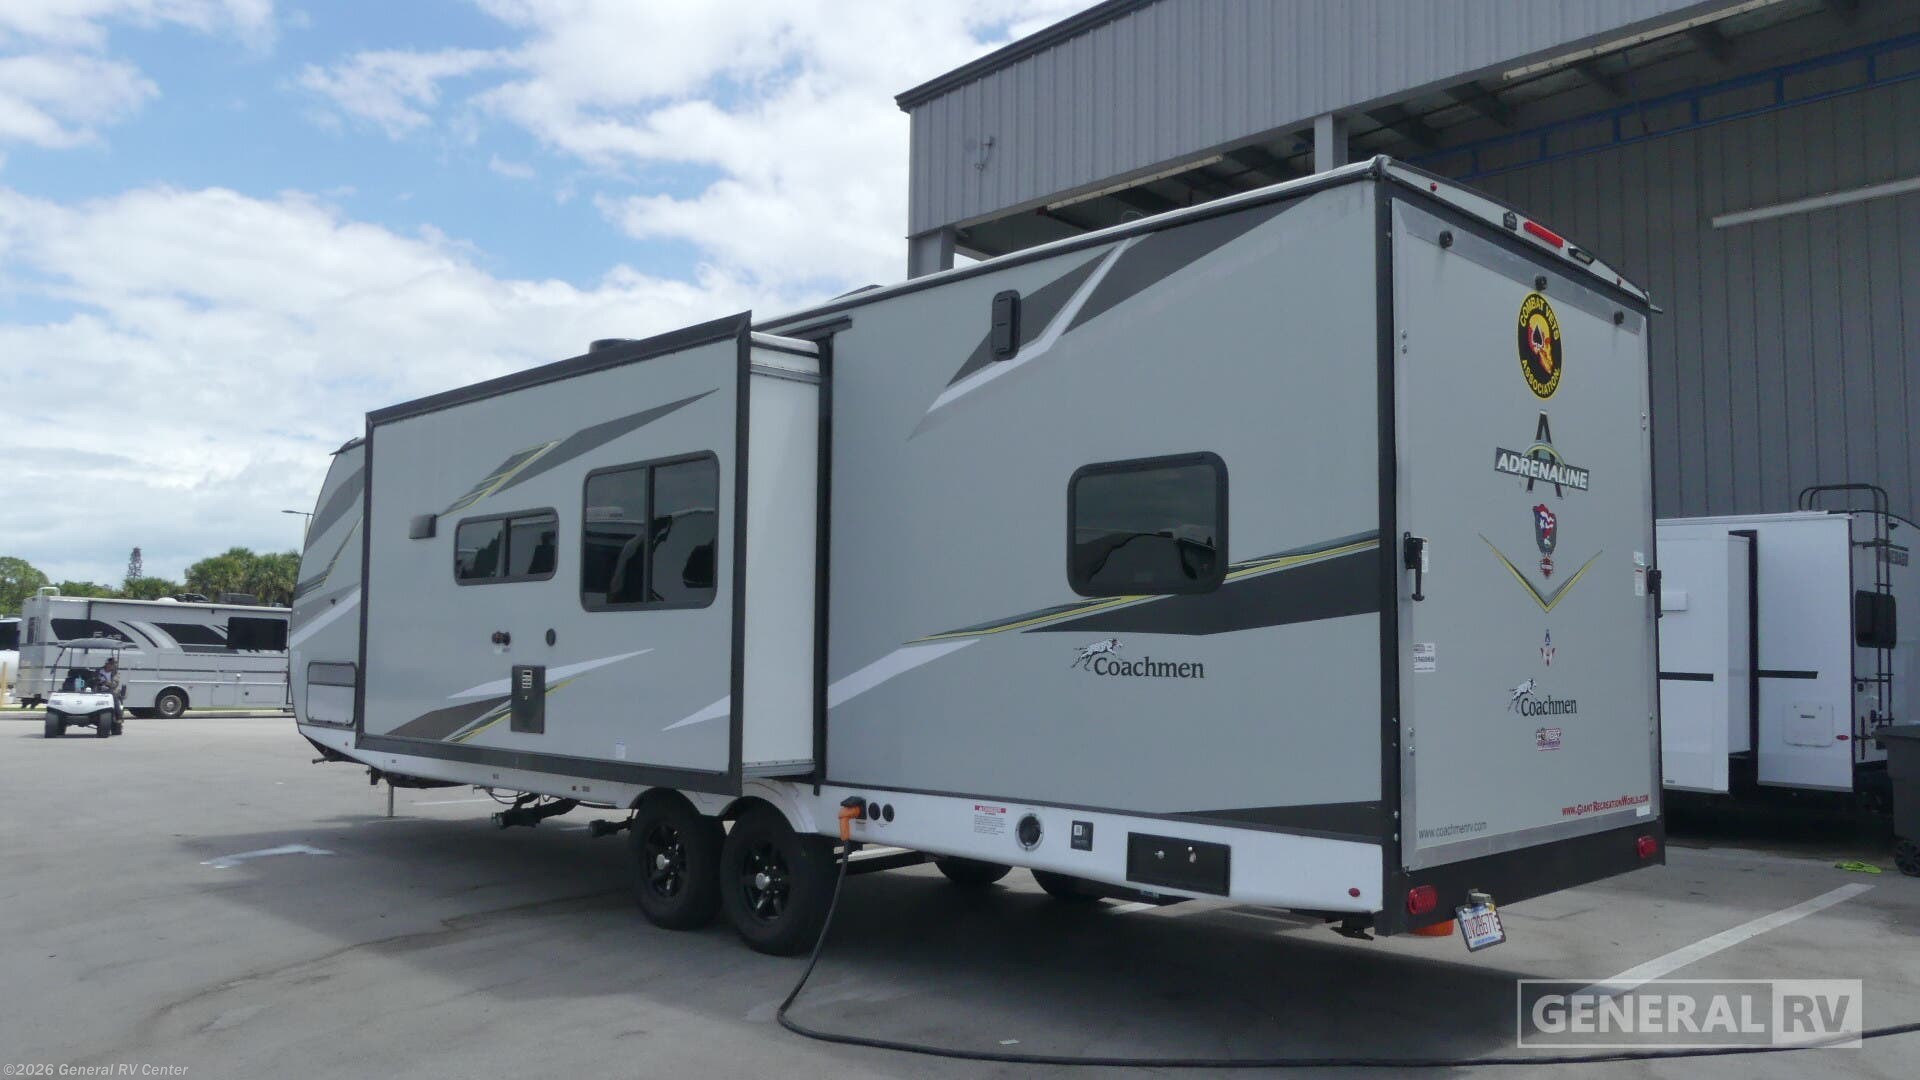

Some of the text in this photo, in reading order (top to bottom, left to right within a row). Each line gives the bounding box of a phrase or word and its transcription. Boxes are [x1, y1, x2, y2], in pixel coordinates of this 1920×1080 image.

[1519, 297, 1560, 341] COMBAT VETS
[1522, 359, 1560, 395] ASSOCIATION
[1497, 453, 1588, 489] ADRENALINE
[1094, 656, 1205, 678] Coachmen
[1521, 695, 1577, 717] Coachmen
[1418, 822, 1487, 839] www.coachmenrv.com
